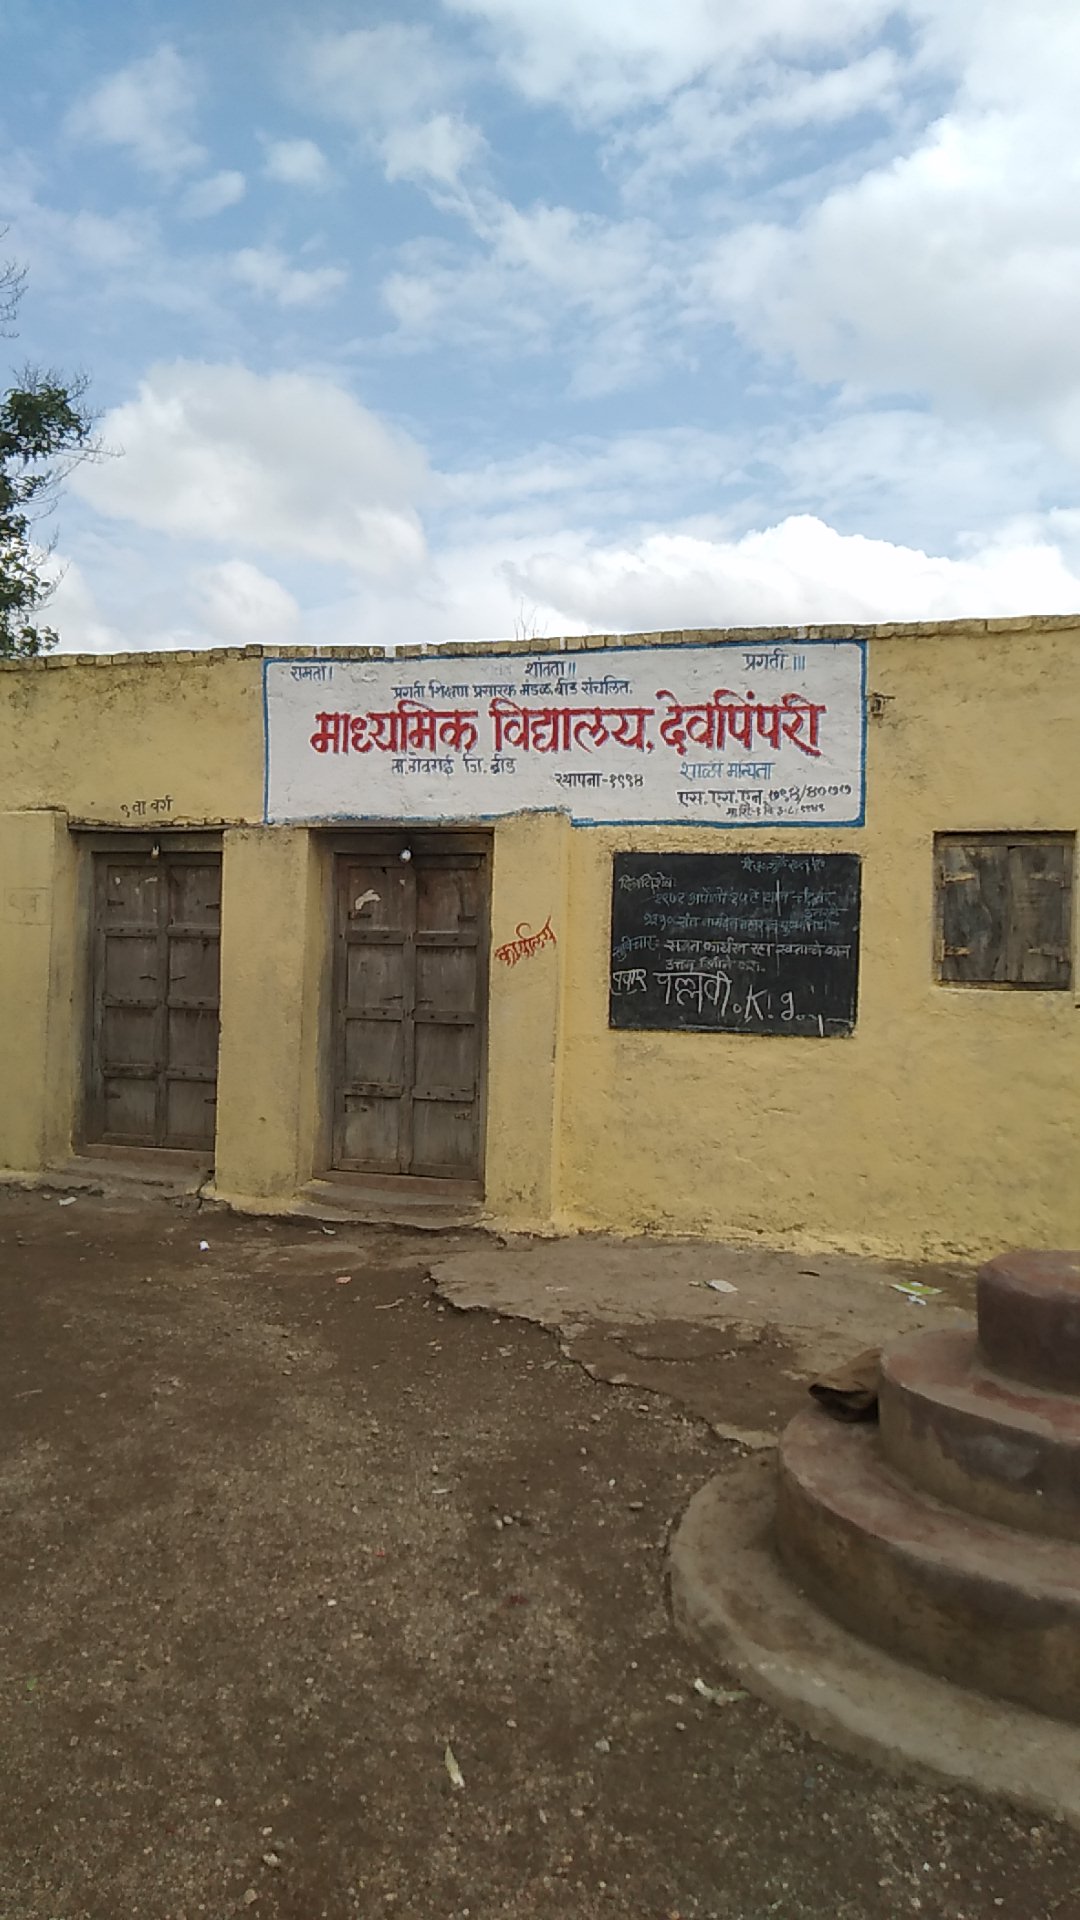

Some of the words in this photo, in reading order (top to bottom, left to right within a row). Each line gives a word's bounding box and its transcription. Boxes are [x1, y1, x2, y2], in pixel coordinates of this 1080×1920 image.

[391, 680, 426, 699] प्रगती
[428, 679, 469, 699] शिक्षण
[473, 683, 517, 698] प्रसारक
[310, 700, 479, 754] माध्यमिक
[656, 689, 827, 757] देवपिंपरी
[726, 762, 776, 780] मान्यता
